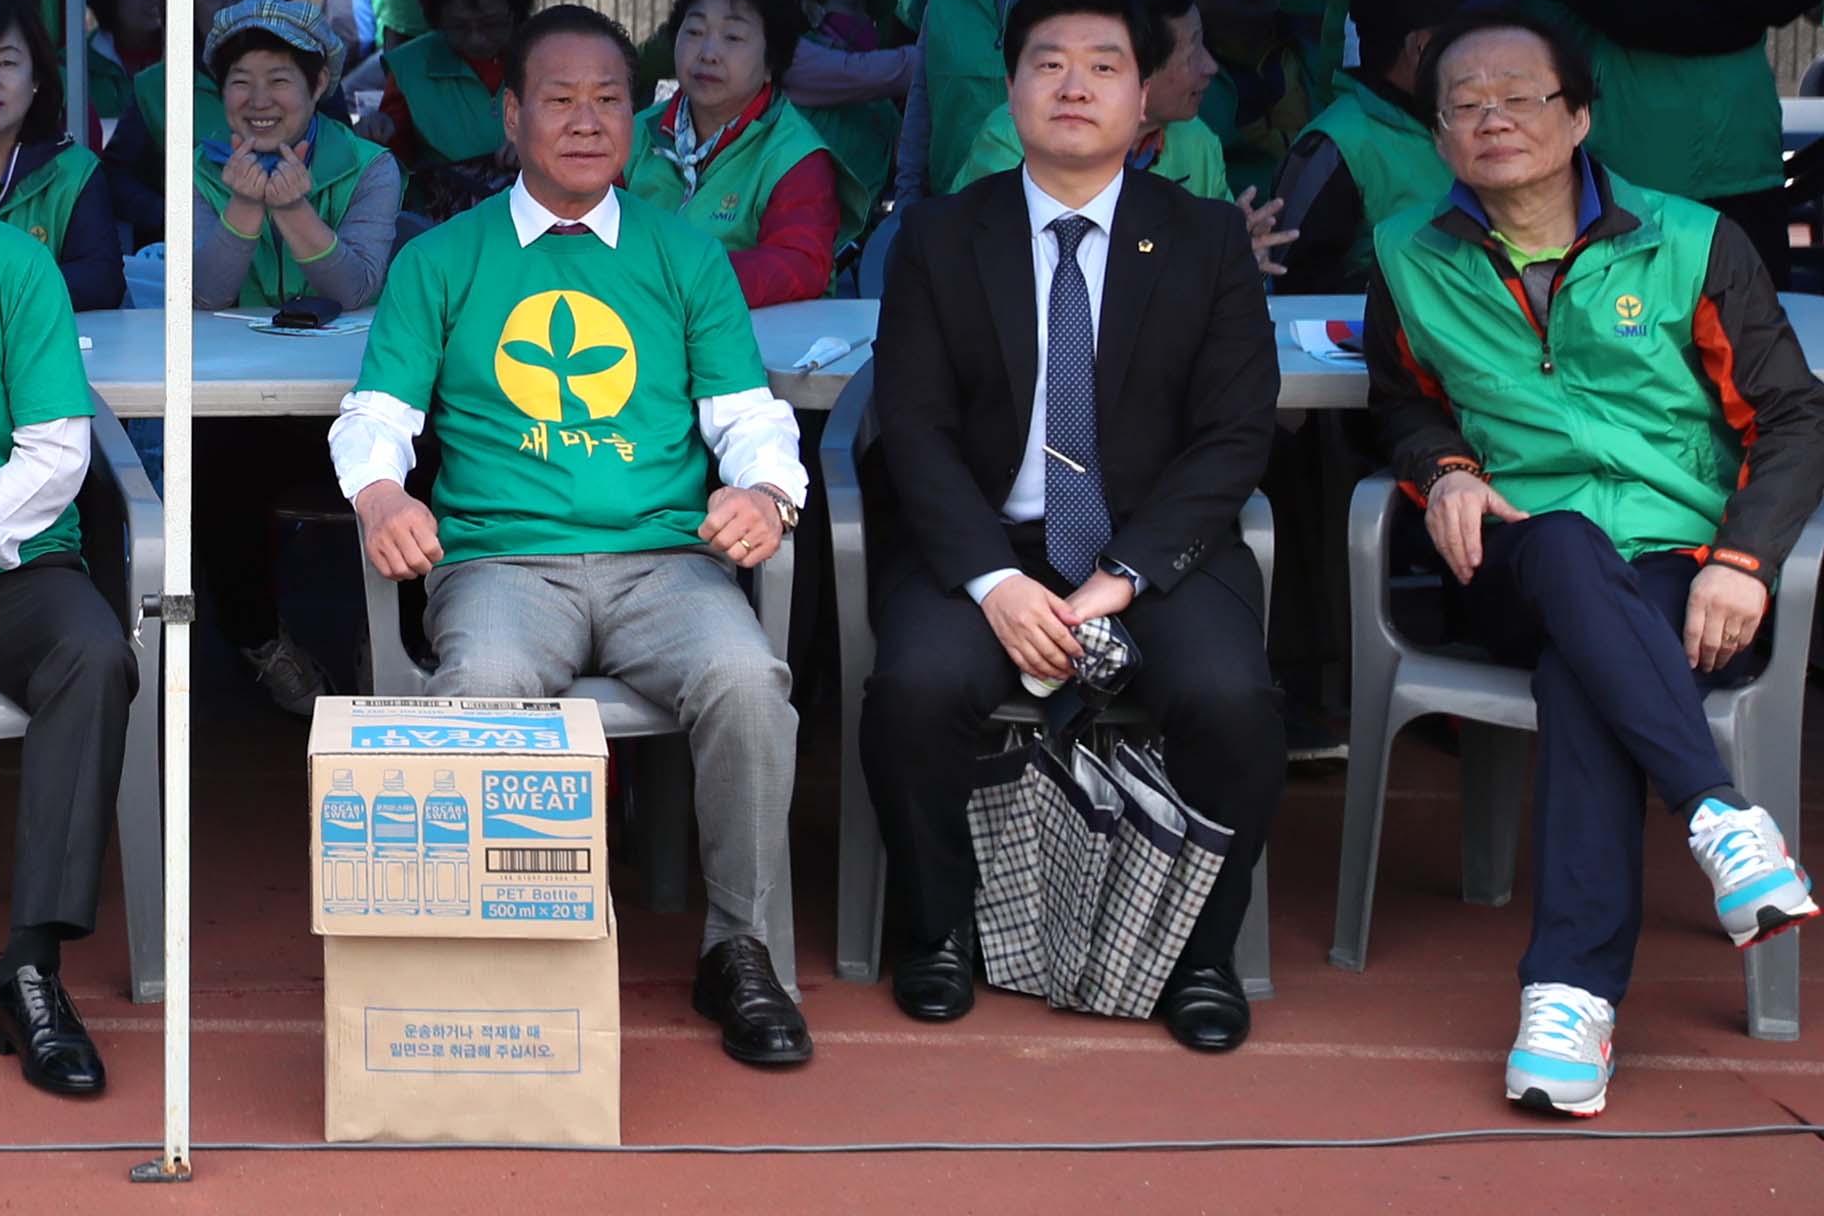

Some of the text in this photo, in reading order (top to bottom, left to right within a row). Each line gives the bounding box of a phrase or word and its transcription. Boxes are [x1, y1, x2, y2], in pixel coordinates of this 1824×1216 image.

[1615, 324, 1647, 337] SMU
[484, 775, 588, 793] POCARI
[485, 793, 580, 811] SWEAT
[497, 888, 578, 902] PET Bottle
[488, 903, 517, 918] 500
[519, 904, 536, 918] ml
[552, 904, 571, 919] 20
[404, 1024, 541, 1040] 운송하거나 적재할 때
[450, 1044, 491, 1059] 취급해
[496, 1044, 555, 1060] 주십시오.
